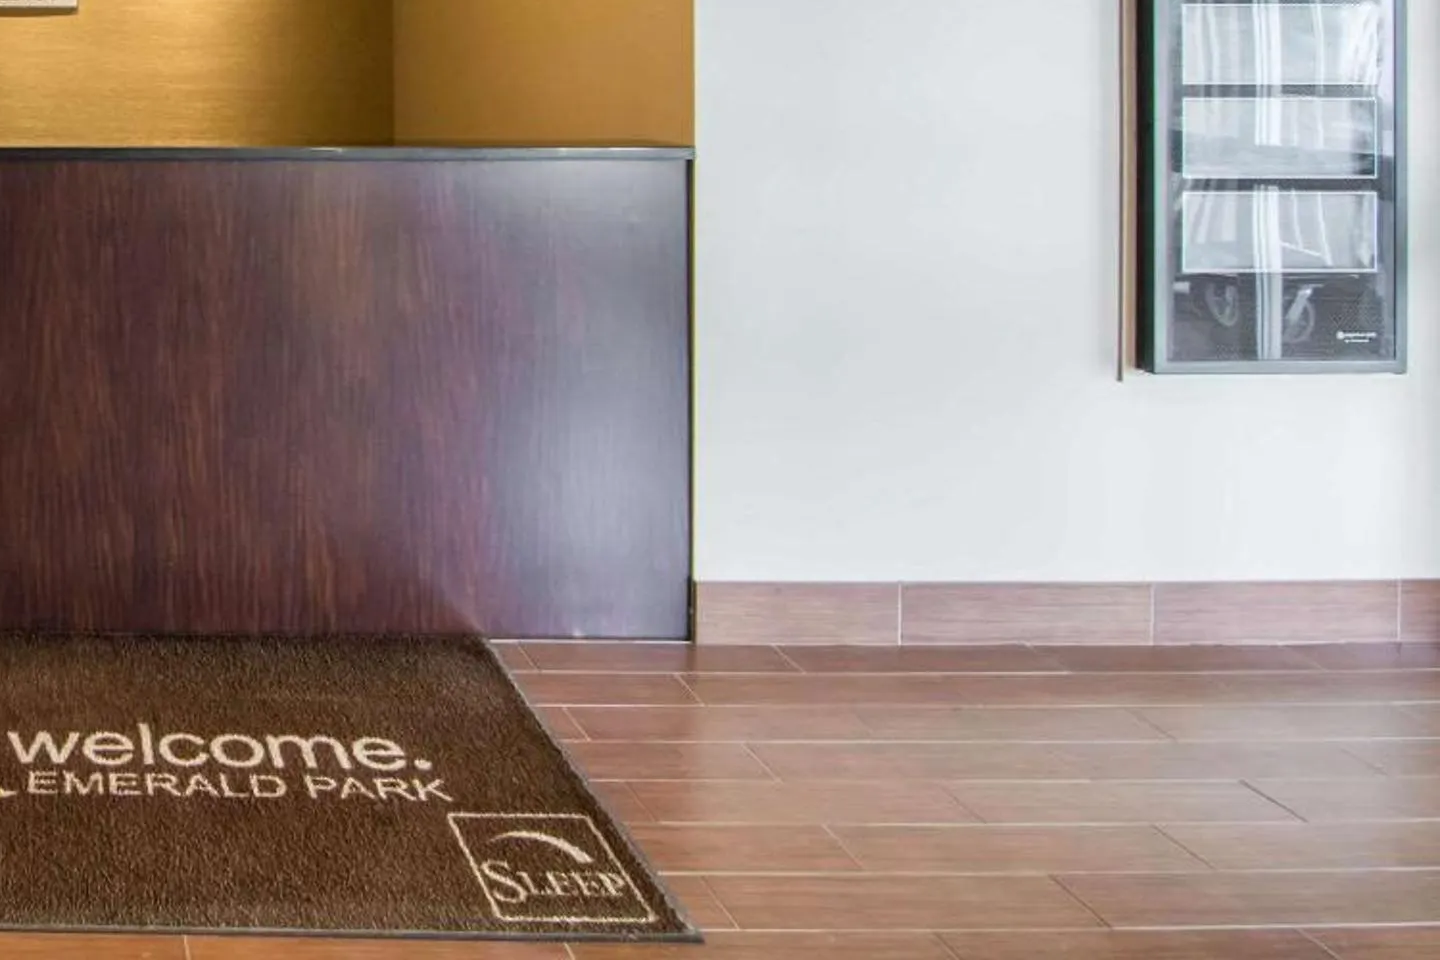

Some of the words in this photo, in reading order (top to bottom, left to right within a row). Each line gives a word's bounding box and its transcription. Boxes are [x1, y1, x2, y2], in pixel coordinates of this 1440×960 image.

[6, 723, 433, 771] welcome.
[27, 771, 287, 798] EMERALD
[304, 775, 454, 802] PARK
[480, 859, 626, 903] SLEEP
